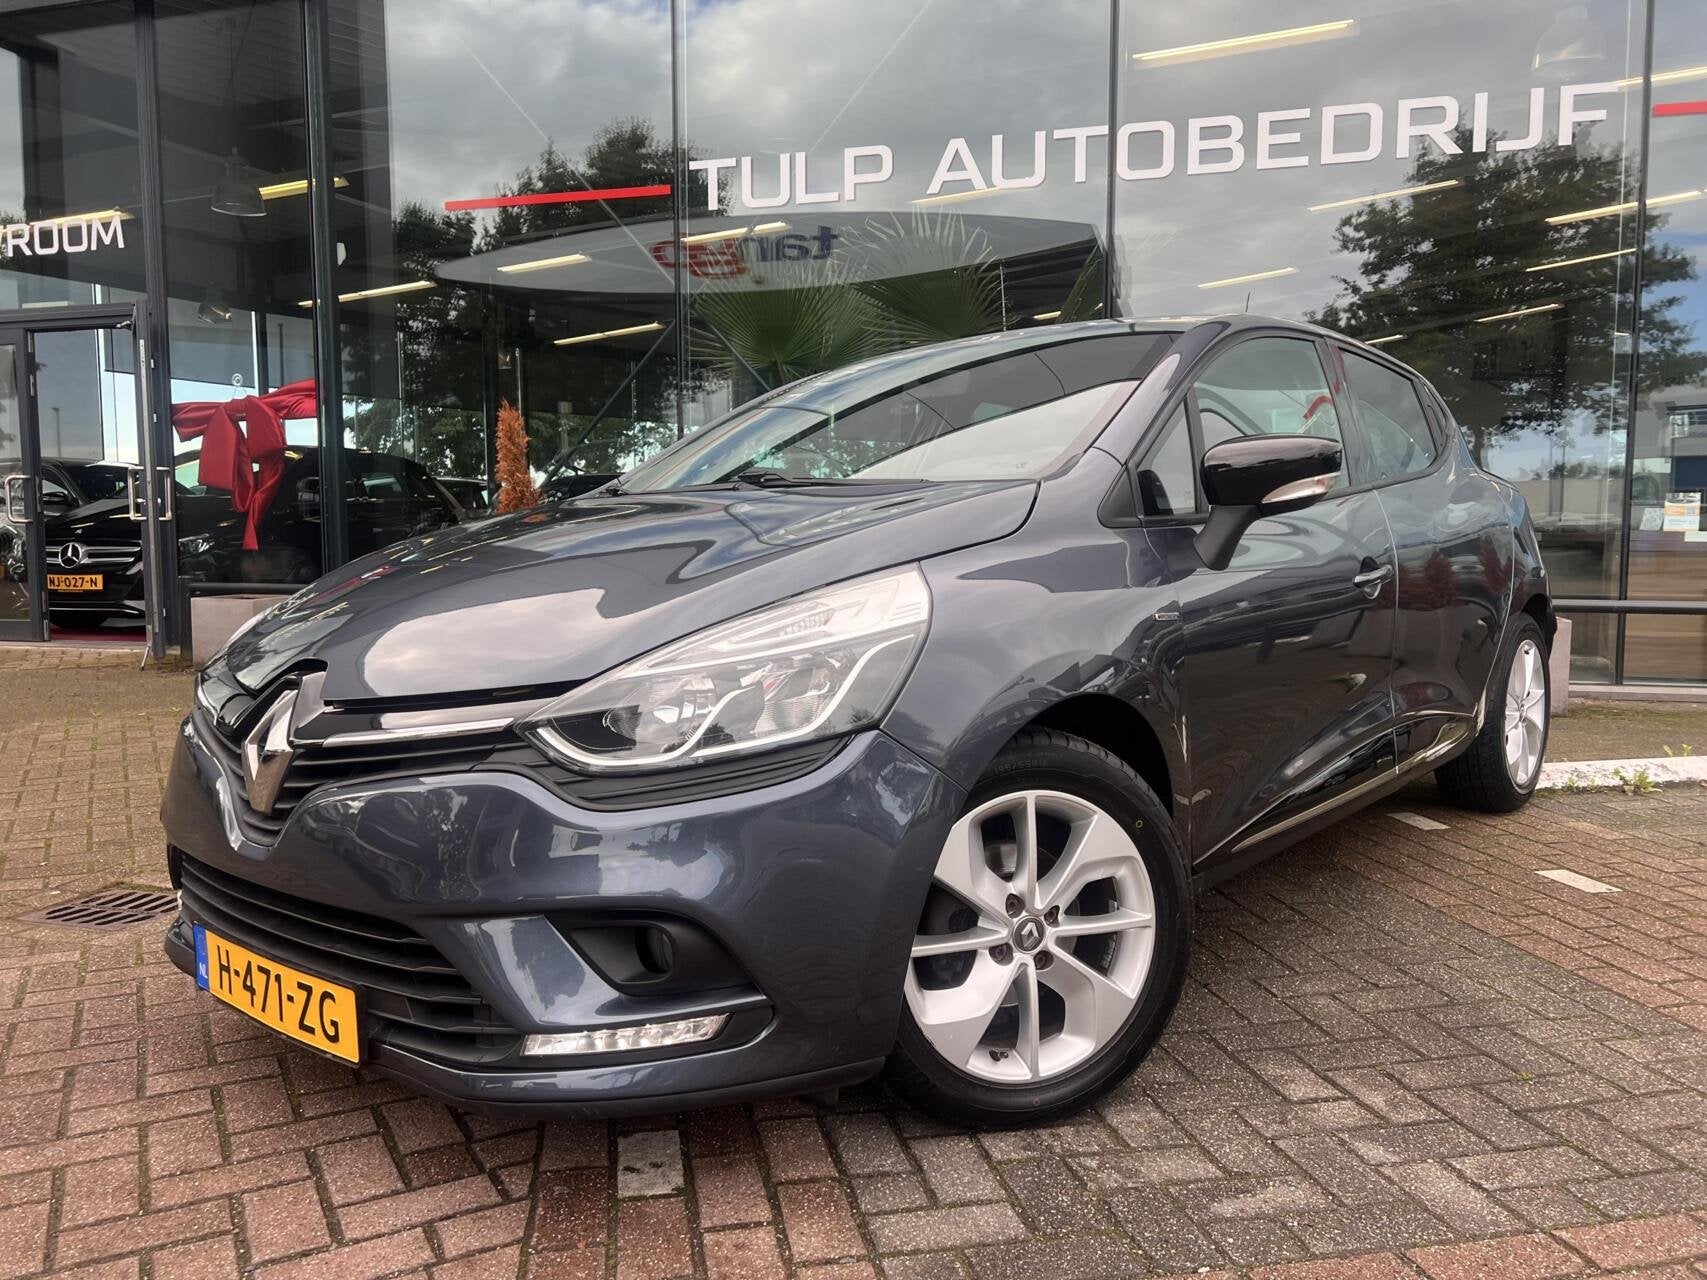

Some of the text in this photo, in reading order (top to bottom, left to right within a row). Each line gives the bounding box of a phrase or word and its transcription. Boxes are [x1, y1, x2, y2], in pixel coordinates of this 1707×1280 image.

[689, 82, 1621, 211] TULP AUTOBEDRIJF
[0, 212, 125, 257] ROOM
[48, 576, 98, 588] NJ-027-N
[217, 945, 340, 1043] H-471-ZG
